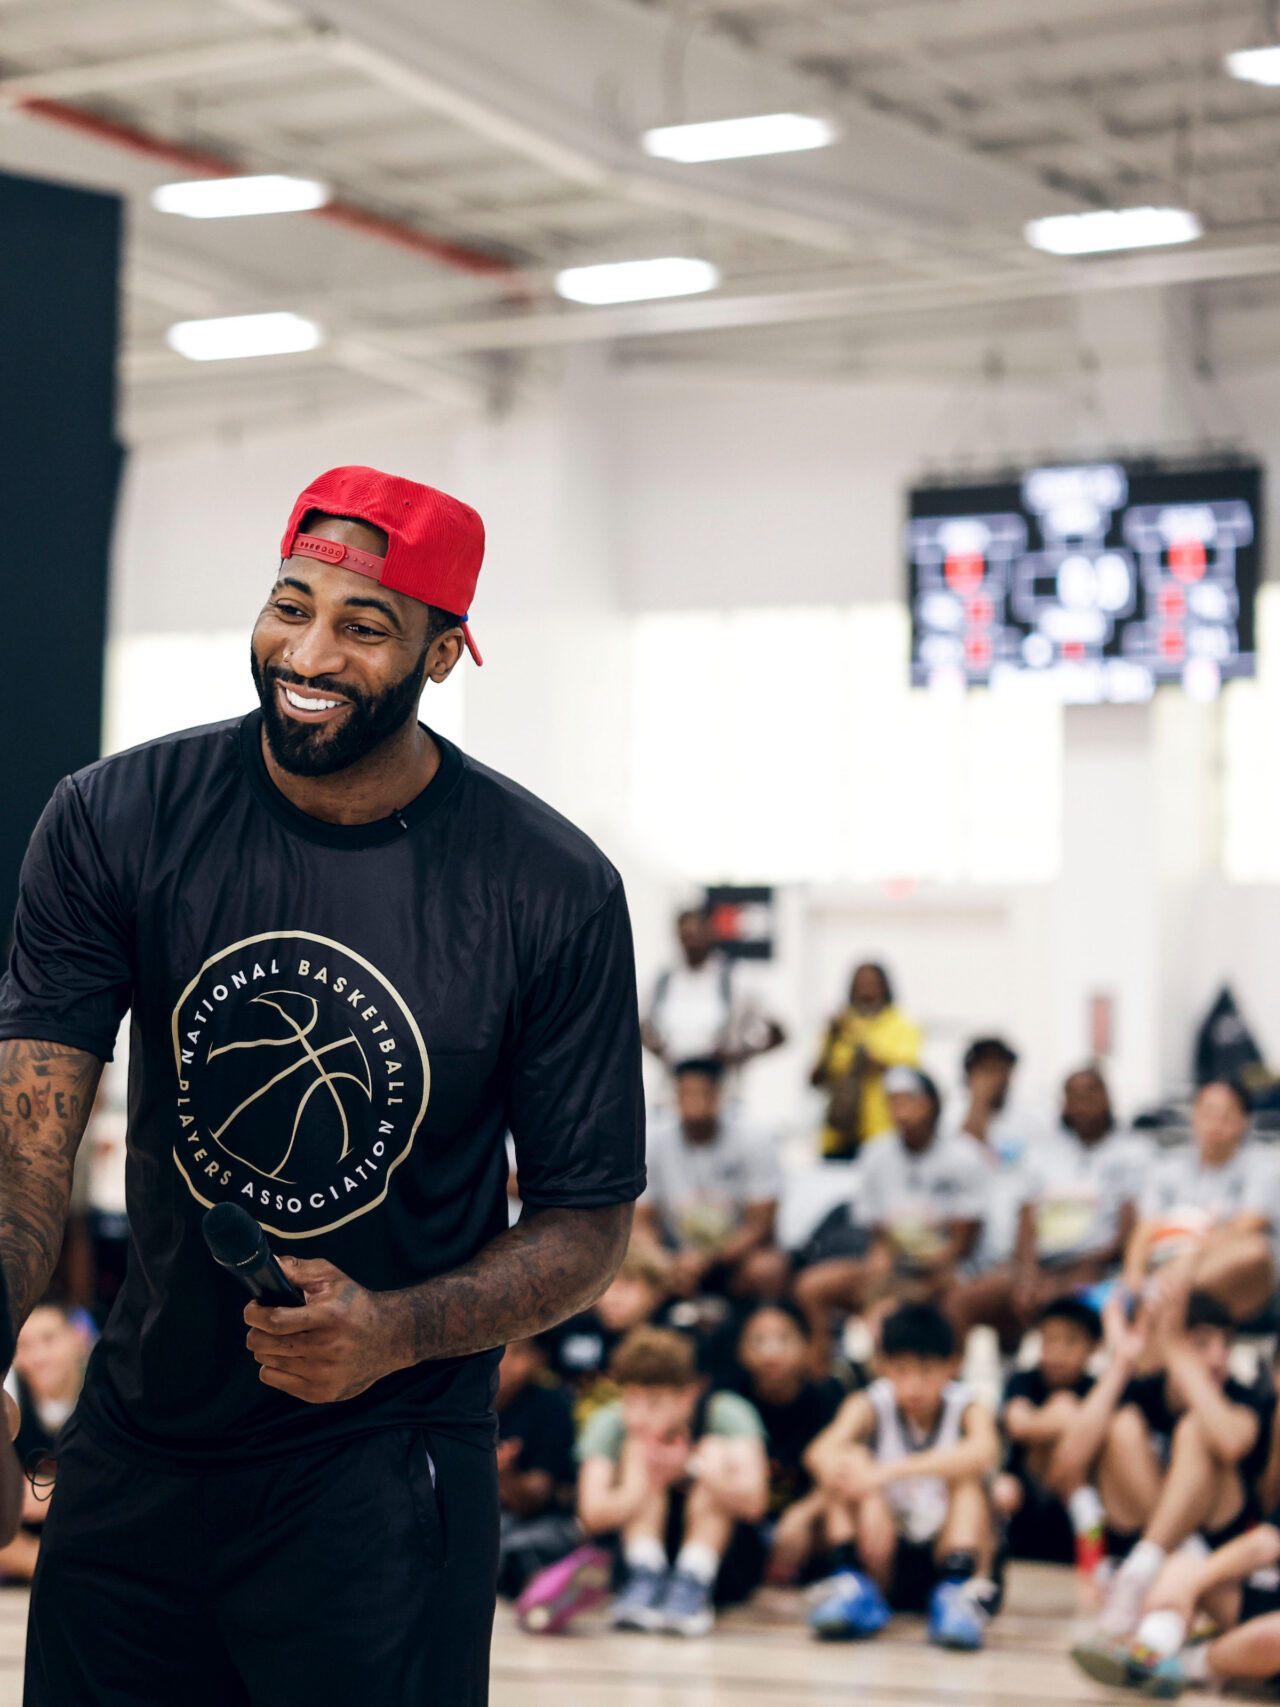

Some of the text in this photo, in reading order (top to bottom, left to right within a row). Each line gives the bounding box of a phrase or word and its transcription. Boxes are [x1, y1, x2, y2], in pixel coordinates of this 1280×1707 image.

[177, 958, 405, 1214] NATIONAL BASKETBALL PLAYERS ASSOCIATION
